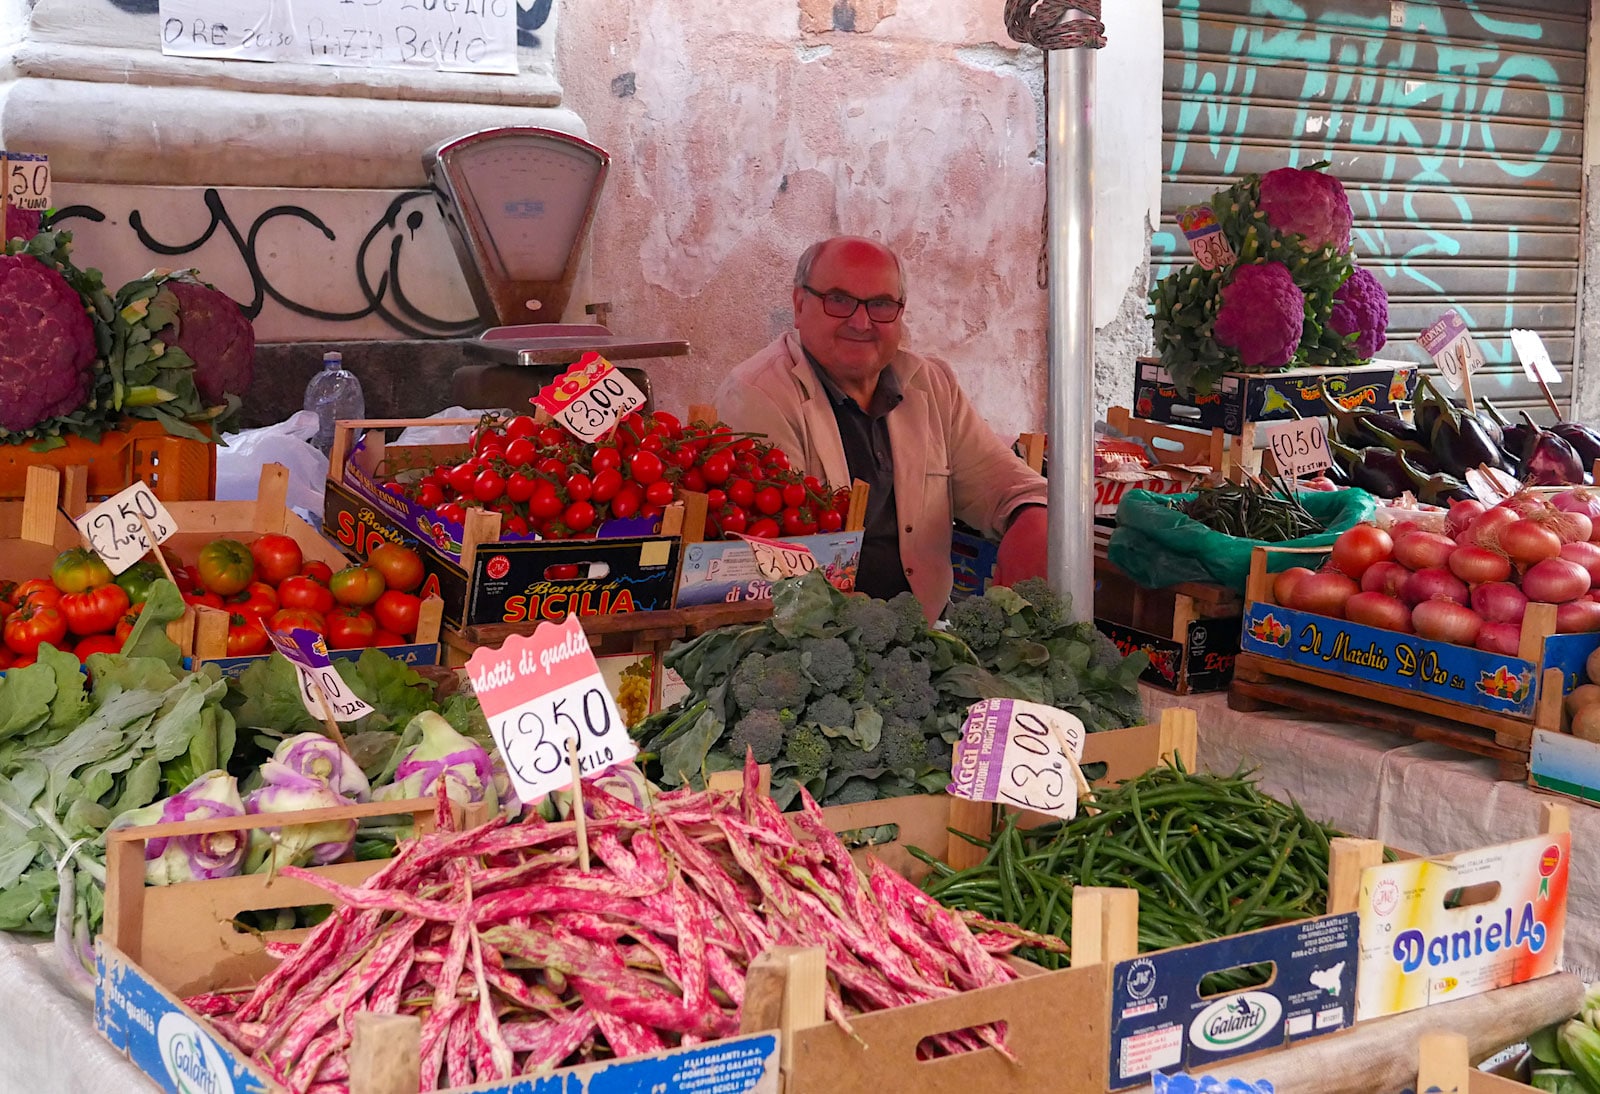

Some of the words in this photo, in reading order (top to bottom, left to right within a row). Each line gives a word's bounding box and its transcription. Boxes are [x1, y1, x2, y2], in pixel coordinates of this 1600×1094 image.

[164, 18, 229, 46] ORE
[564, 378, 624, 436] €3.00
[1272, 426, 1322, 467] €0.50
[139, 524, 167, 551] KLO
[524, 580, 598, 595] Bontà
[725, 585, 741, 603] di
[503, 588, 635, 623] SICILIA
[518, 648, 537, 676] di
[1299, 623, 1323, 655] Il
[1322, 630, 1389, 671] Marchio
[1395, 643, 1449, 685] D'Oro
[501, 688, 611, 785] €3.50
[578, 745, 614, 775] KILO
[1000, 713, 1065, 810] €3.00
[1393, 901, 1546, 973] DanielA
[126, 1000, 156, 1036] qualità
[1210, 1007, 1261, 1037] Galanti
[175, 1040, 217, 1094] Galanti
[705, 1050, 741, 1064] GALANTI
